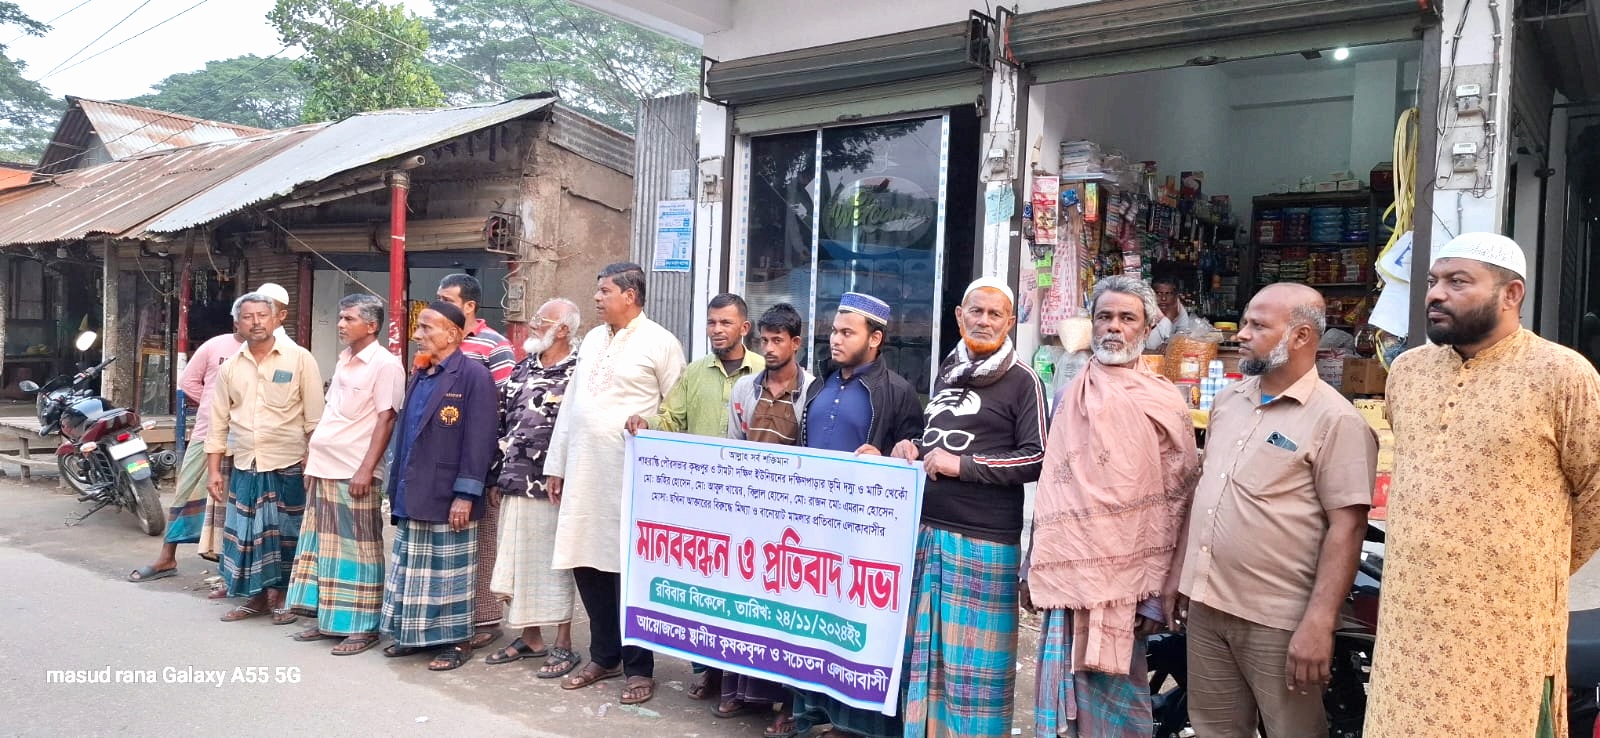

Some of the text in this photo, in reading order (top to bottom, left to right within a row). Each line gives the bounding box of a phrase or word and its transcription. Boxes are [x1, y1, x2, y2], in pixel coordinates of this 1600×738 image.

[711, 465, 716, 474] ও
[827, 477, 841, 493] ভূমি
[857, 486, 864, 495] ও
[866, 483, 884, 497] মাটি
[753, 507, 758, 516] ও
[812, 513, 842, 529] প্রতিবাদে
[842, 520, 886, 537] এলাকাবাসীর
[843, 501, 865, 516] এমরান
[635, 520, 902, 612] মানববন্ধন ও প্রতিবাদ সভা
[655, 580, 687, 605] রবিবার
[688, 625, 718, 648] স্থানীয়
[718, 634, 768, 664] কৃষকবৃন্দ
[770, 647, 780, 662] ও
[782, 649, 825, 675] সচেতন
[827, 661, 889, 692] এলাকাবাসী
